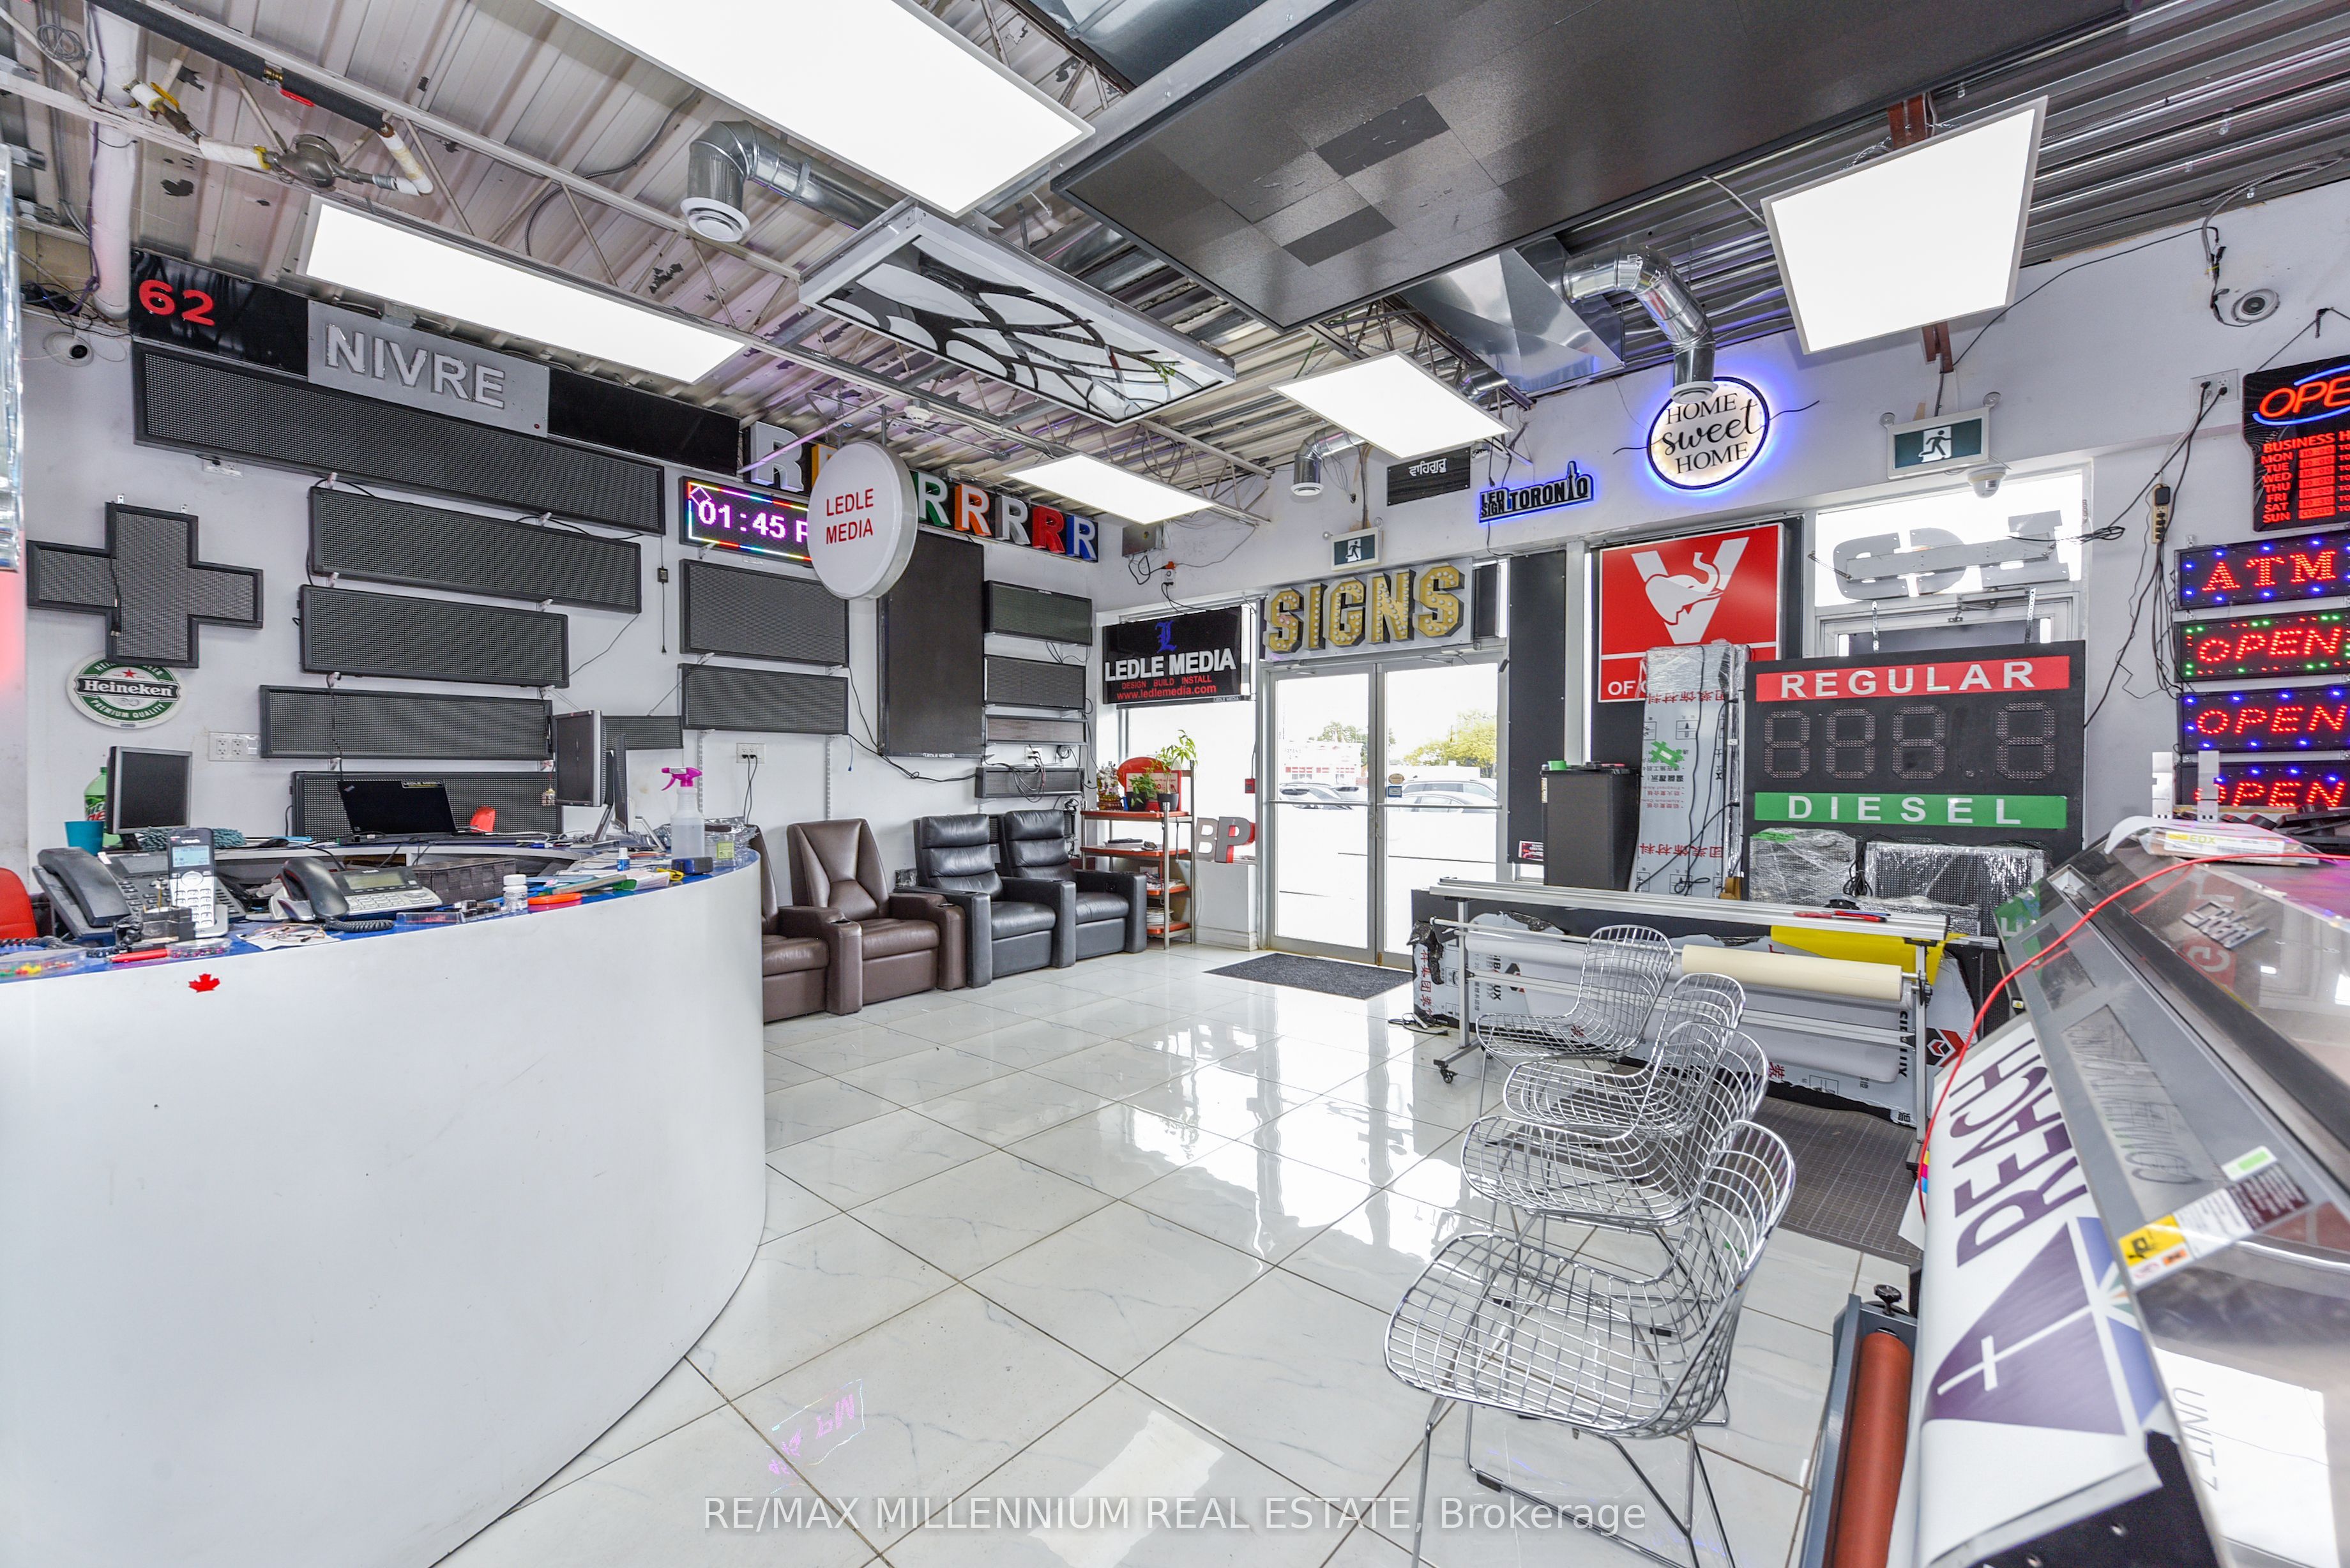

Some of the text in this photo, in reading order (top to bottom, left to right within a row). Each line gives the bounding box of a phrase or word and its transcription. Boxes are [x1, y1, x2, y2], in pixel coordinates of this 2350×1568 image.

[139, 279, 216, 326] 62
[326, 323, 506, 409] NIVRE
[1666, 393, 1738, 425] HOME
[1655, 398, 1765, 455] sweet
[2263, 433, 2335, 453] BUSINESS
[1675, 442, 1749, 474] HOME
[2261, 451, 2293, 464] MON
[2264, 462, 2289, 473] TUE
[2262, 472, 2293, 483] WED
[2264, 482, 2291, 493] THU
[826, 488, 874, 516] LEDLE
[1482, 491, 1505, 504] LED
[1482, 502, 1505, 517] SIGN
[2264, 502, 2289, 513] SAT
[2266, 493, 2287, 502] FRI
[698, 499, 786, 539] 01:45
[2263, 512, 2291, 523] SUN
[826, 518, 873, 544] MEDIA
[2202, 550, 2337, 591] ATM
[1263, 562, 1465, 653] SIGNS
[2198, 628, 2342, 662] OPEN
[1105, 648, 1236, 681] LEDLE MEDIA
[84, 680, 173, 697] Heineken
[1117, 684, 1217, 700] www.ledlemedia.com
[1121, 675, 1212, 690] DESIGN BUILD INSTALL
[1607, 681, 1636, 695] OF
[1781, 661, 2035, 698] REGULAR
[91, 699, 166, 718] PREMIUM QUALITY
[2197, 704, 2348, 735] OPEN
[1788, 796, 2021, 825] DIESEL
[1949, 1039, 2087, 1267] REACH
